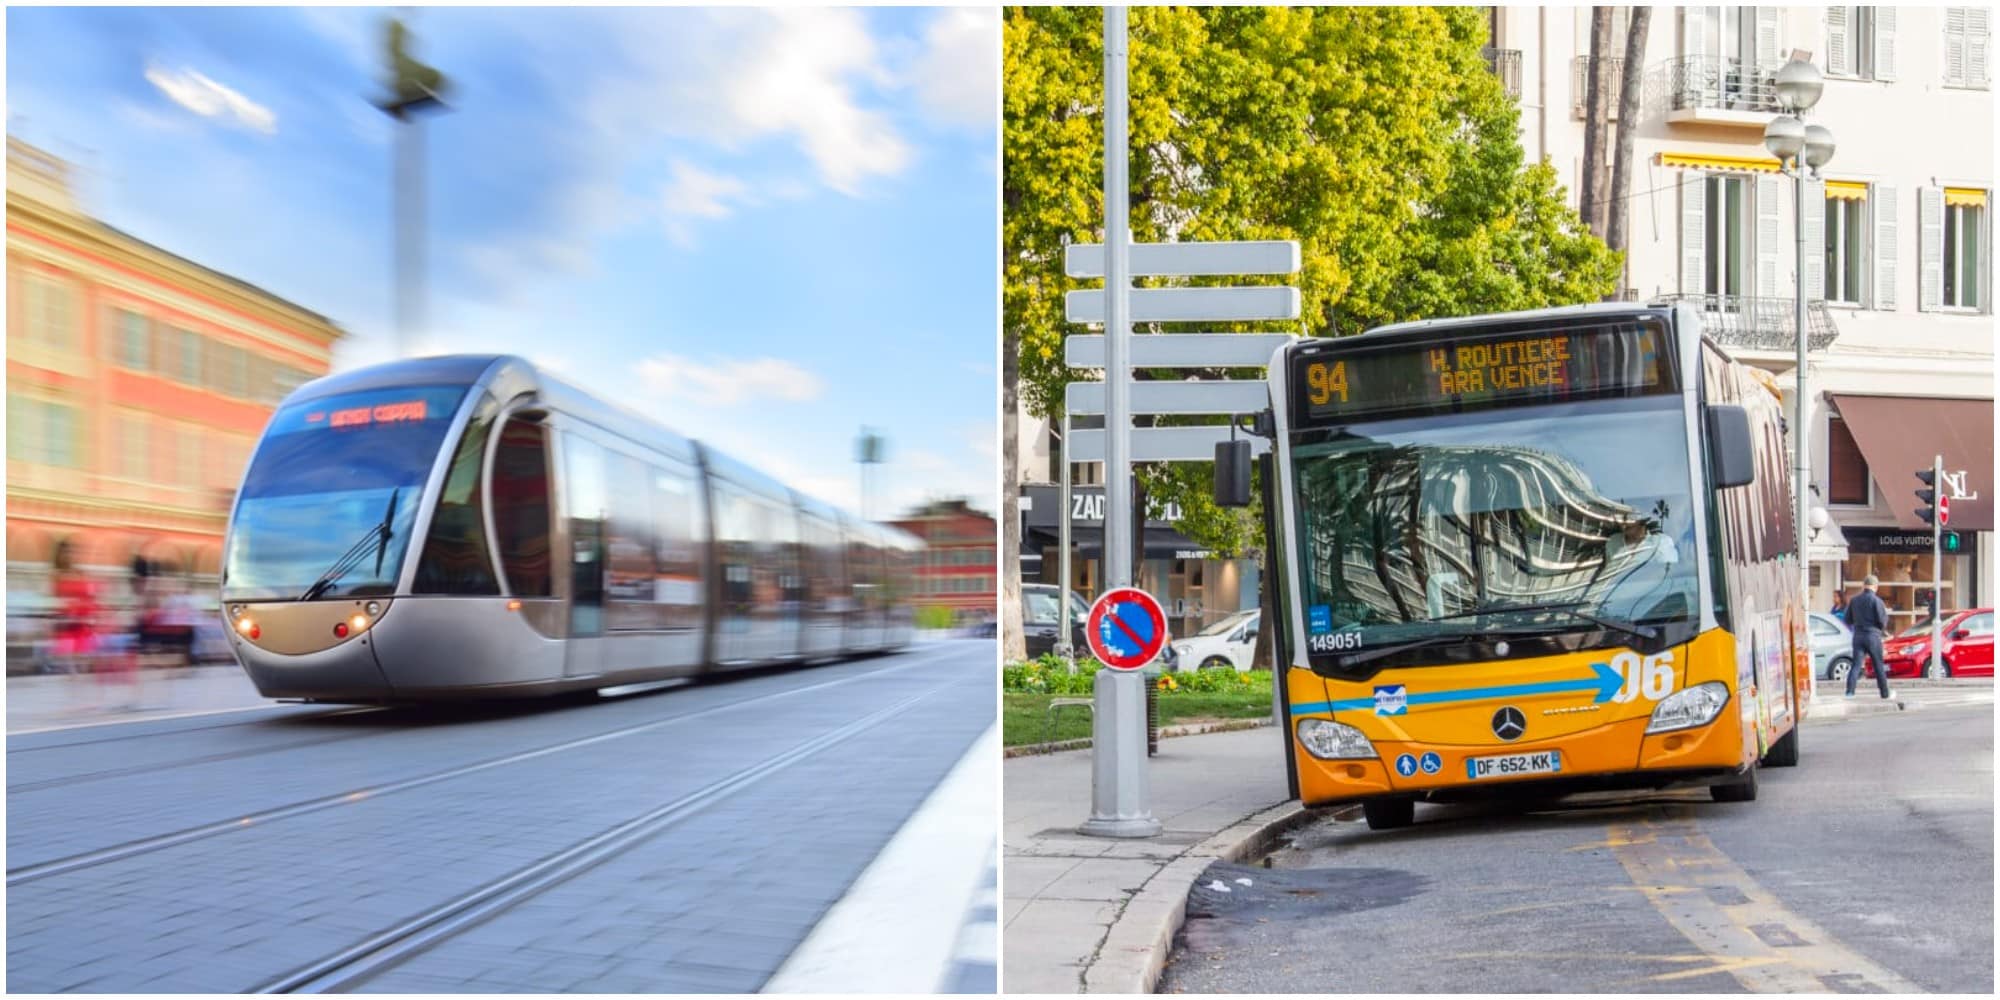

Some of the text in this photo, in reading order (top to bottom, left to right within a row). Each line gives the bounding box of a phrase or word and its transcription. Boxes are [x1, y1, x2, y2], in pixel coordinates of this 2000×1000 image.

[1429, 337, 1571, 373] H. ROUTIERE
[1307, 360, 1349, 405] 94
[1440, 361, 1564, 395] ARA VENCE
[1071, 494, 1105, 520] ZAD
[1880, 535, 1903, 545] LOUIS
[1310, 631, 1362, 651] 149051
